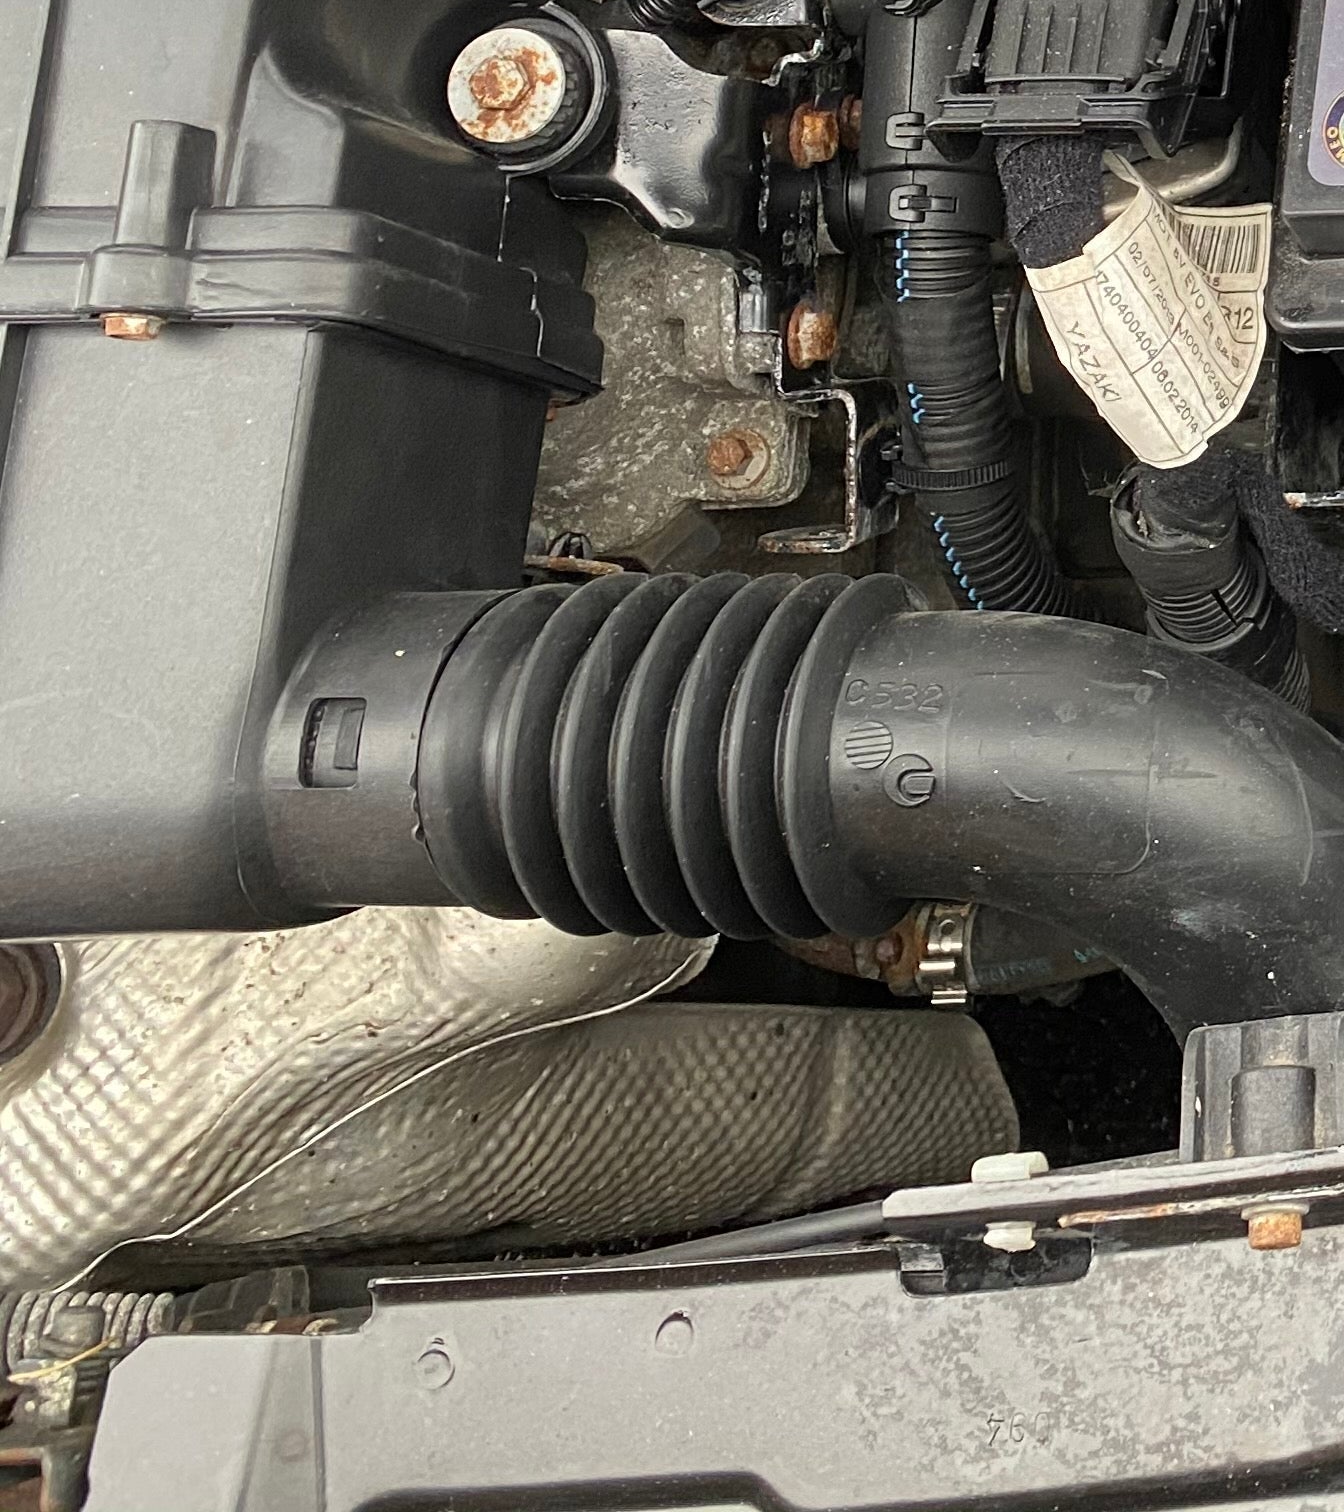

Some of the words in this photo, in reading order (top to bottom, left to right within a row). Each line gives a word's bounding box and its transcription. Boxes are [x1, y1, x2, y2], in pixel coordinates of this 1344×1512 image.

[1184, 273, 1205, 309] EVO
[1066, 321, 1121, 403] YAZAKI
[846, 678, 944, 714] C532
